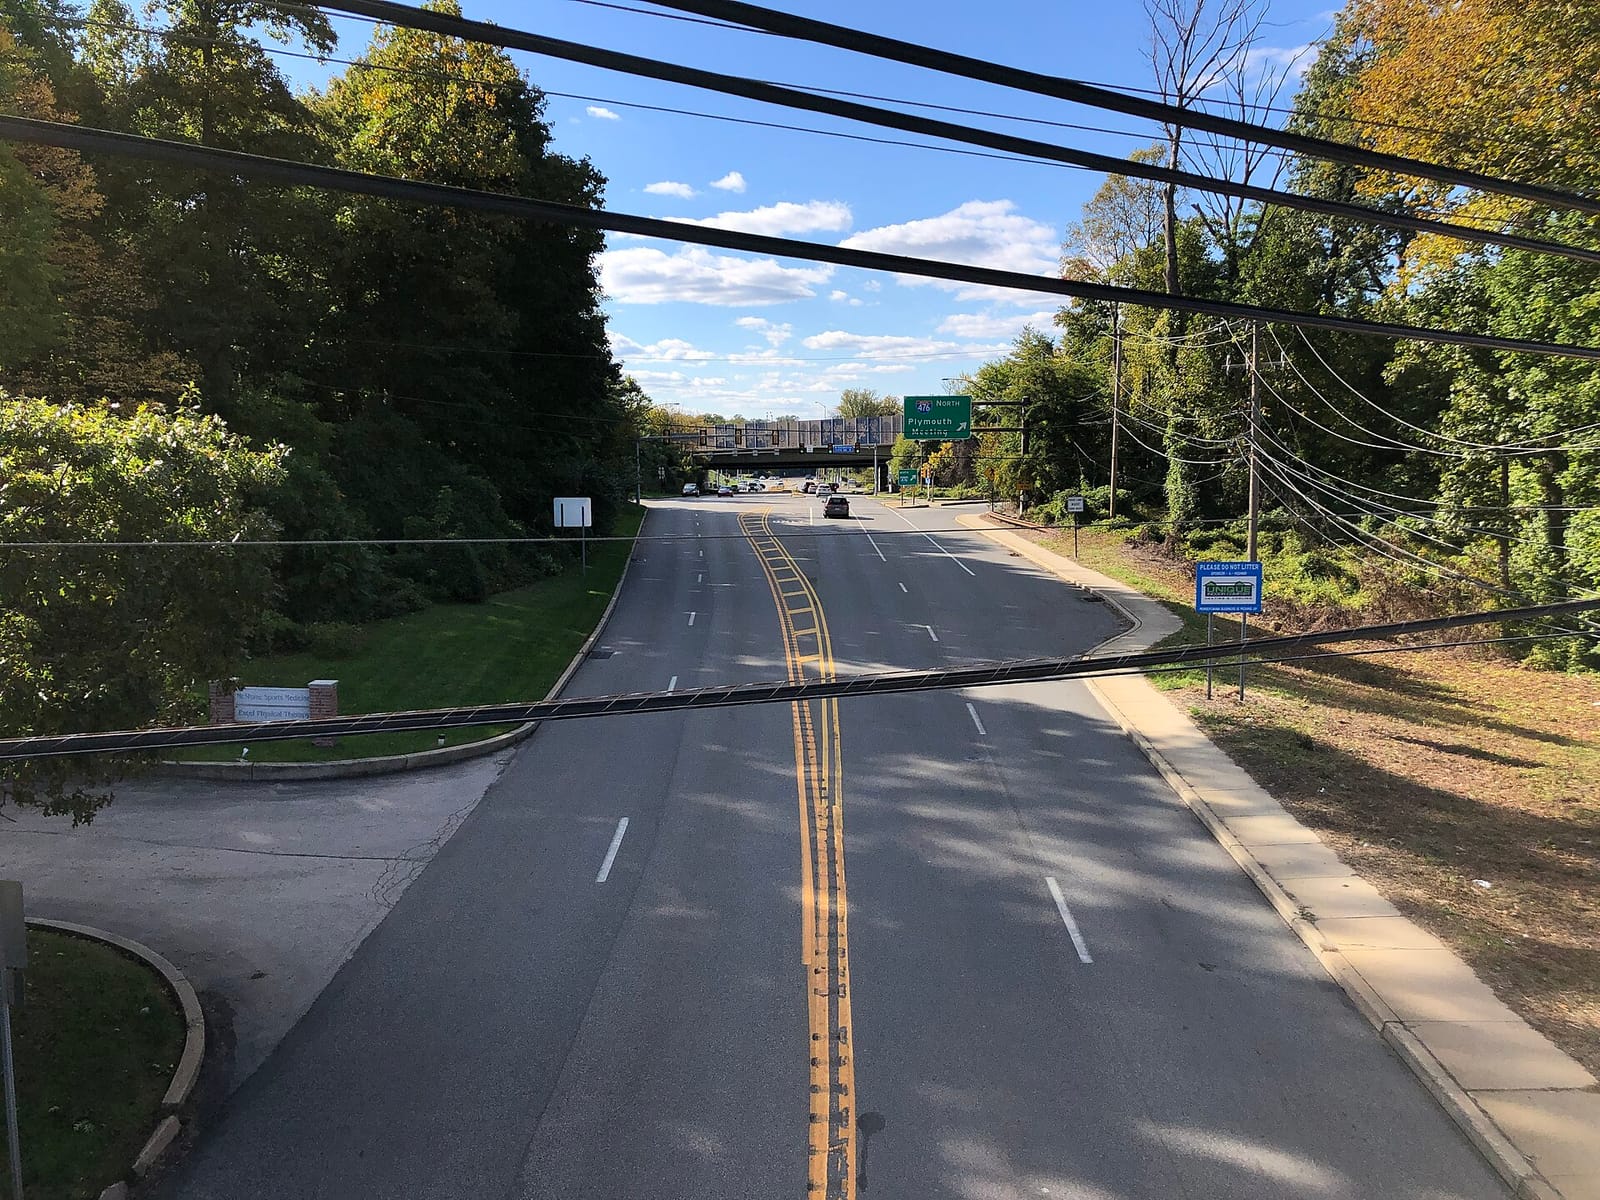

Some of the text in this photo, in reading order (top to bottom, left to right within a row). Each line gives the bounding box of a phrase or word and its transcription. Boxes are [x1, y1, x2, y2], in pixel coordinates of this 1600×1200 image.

[917, 403, 931, 412] 476
[908, 418, 952, 427] Plymouth
[912, 428, 948, 437] Meeting
[264, 694, 284, 702] Sports
[256, 710, 282, 718] Physical
